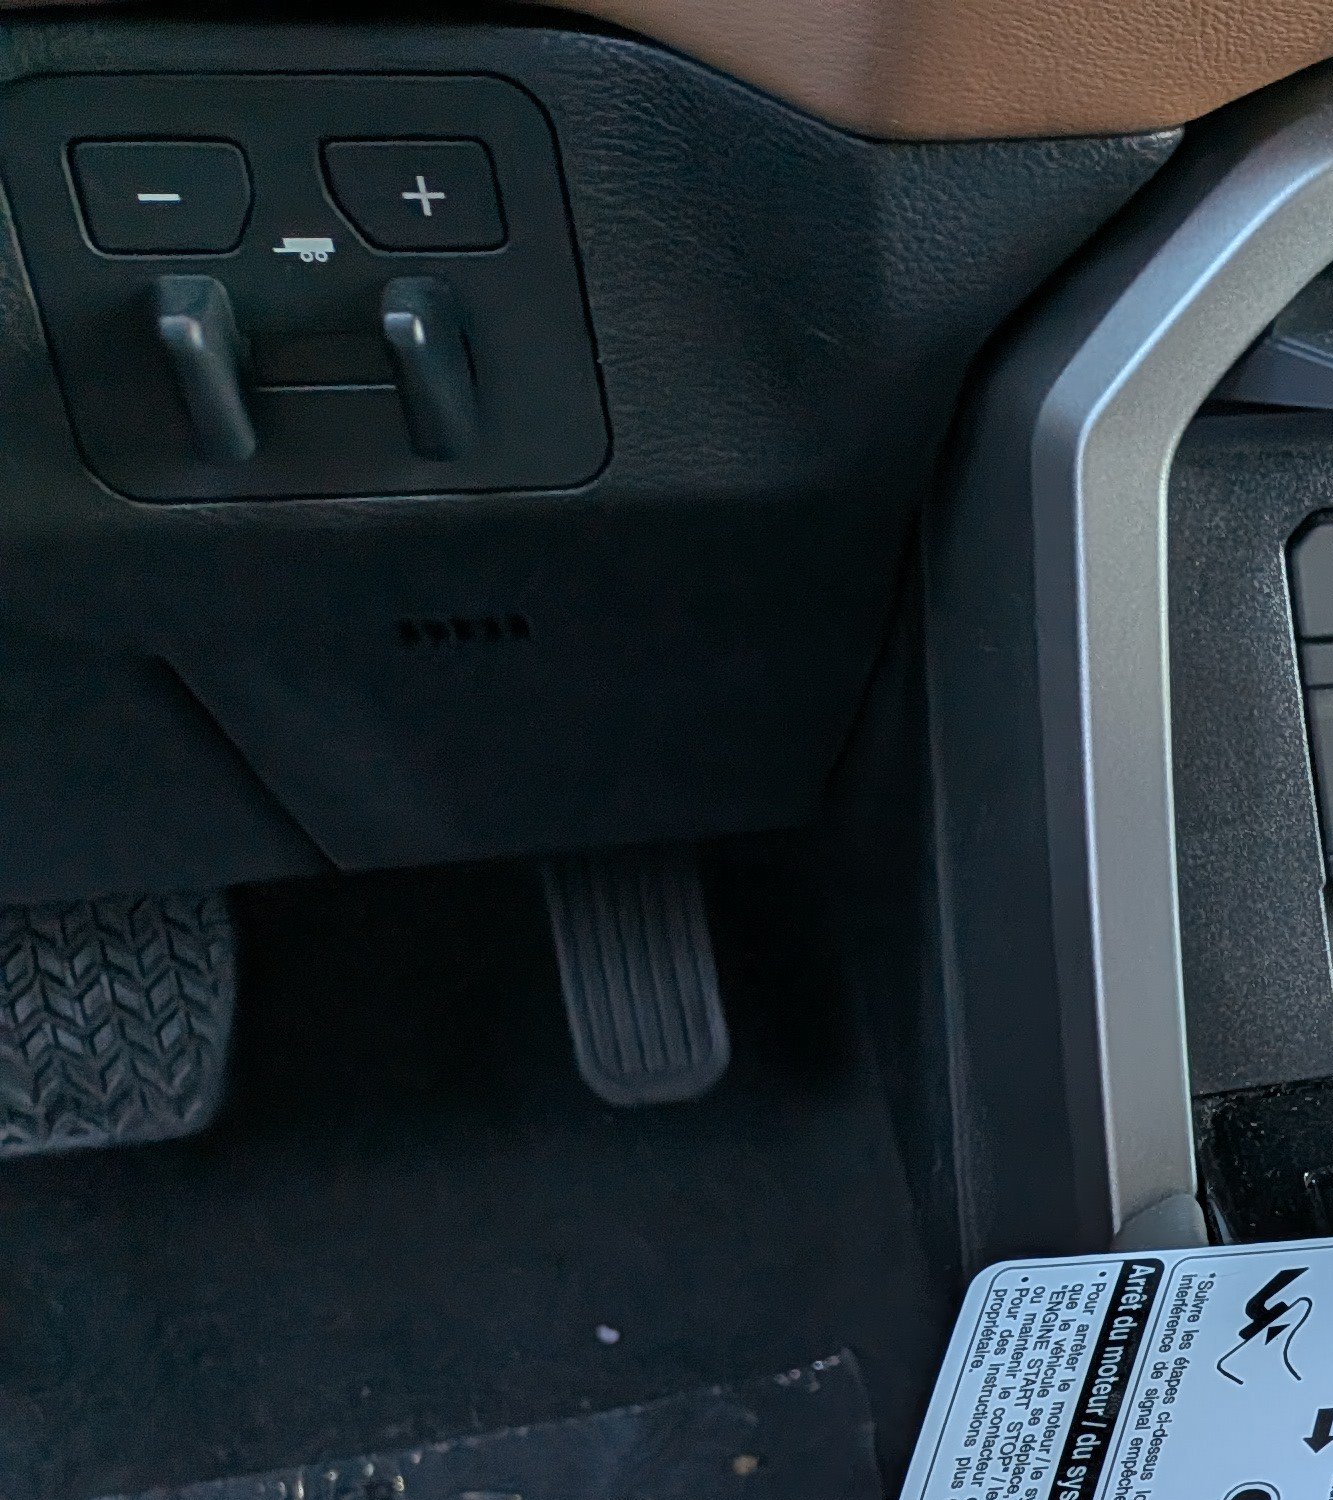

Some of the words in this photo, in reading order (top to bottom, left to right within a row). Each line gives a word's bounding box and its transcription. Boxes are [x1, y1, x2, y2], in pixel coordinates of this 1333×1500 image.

[1004, 1286, 1031, 1321] Pour
[1116, 1263, 1156, 1312] Arrêt
[967, 1287, 1008, 1373] propriétaire.
[992, 1328, 1015, 1356] des
[1107, 1314, 1138, 1341] du
[1084, 1344, 1124, 1416] moteur
[962, 1361, 1006, 1448] instructions
[1070, 1432, 1102, 1460] du
[949, 1455, 973, 1490] plus
